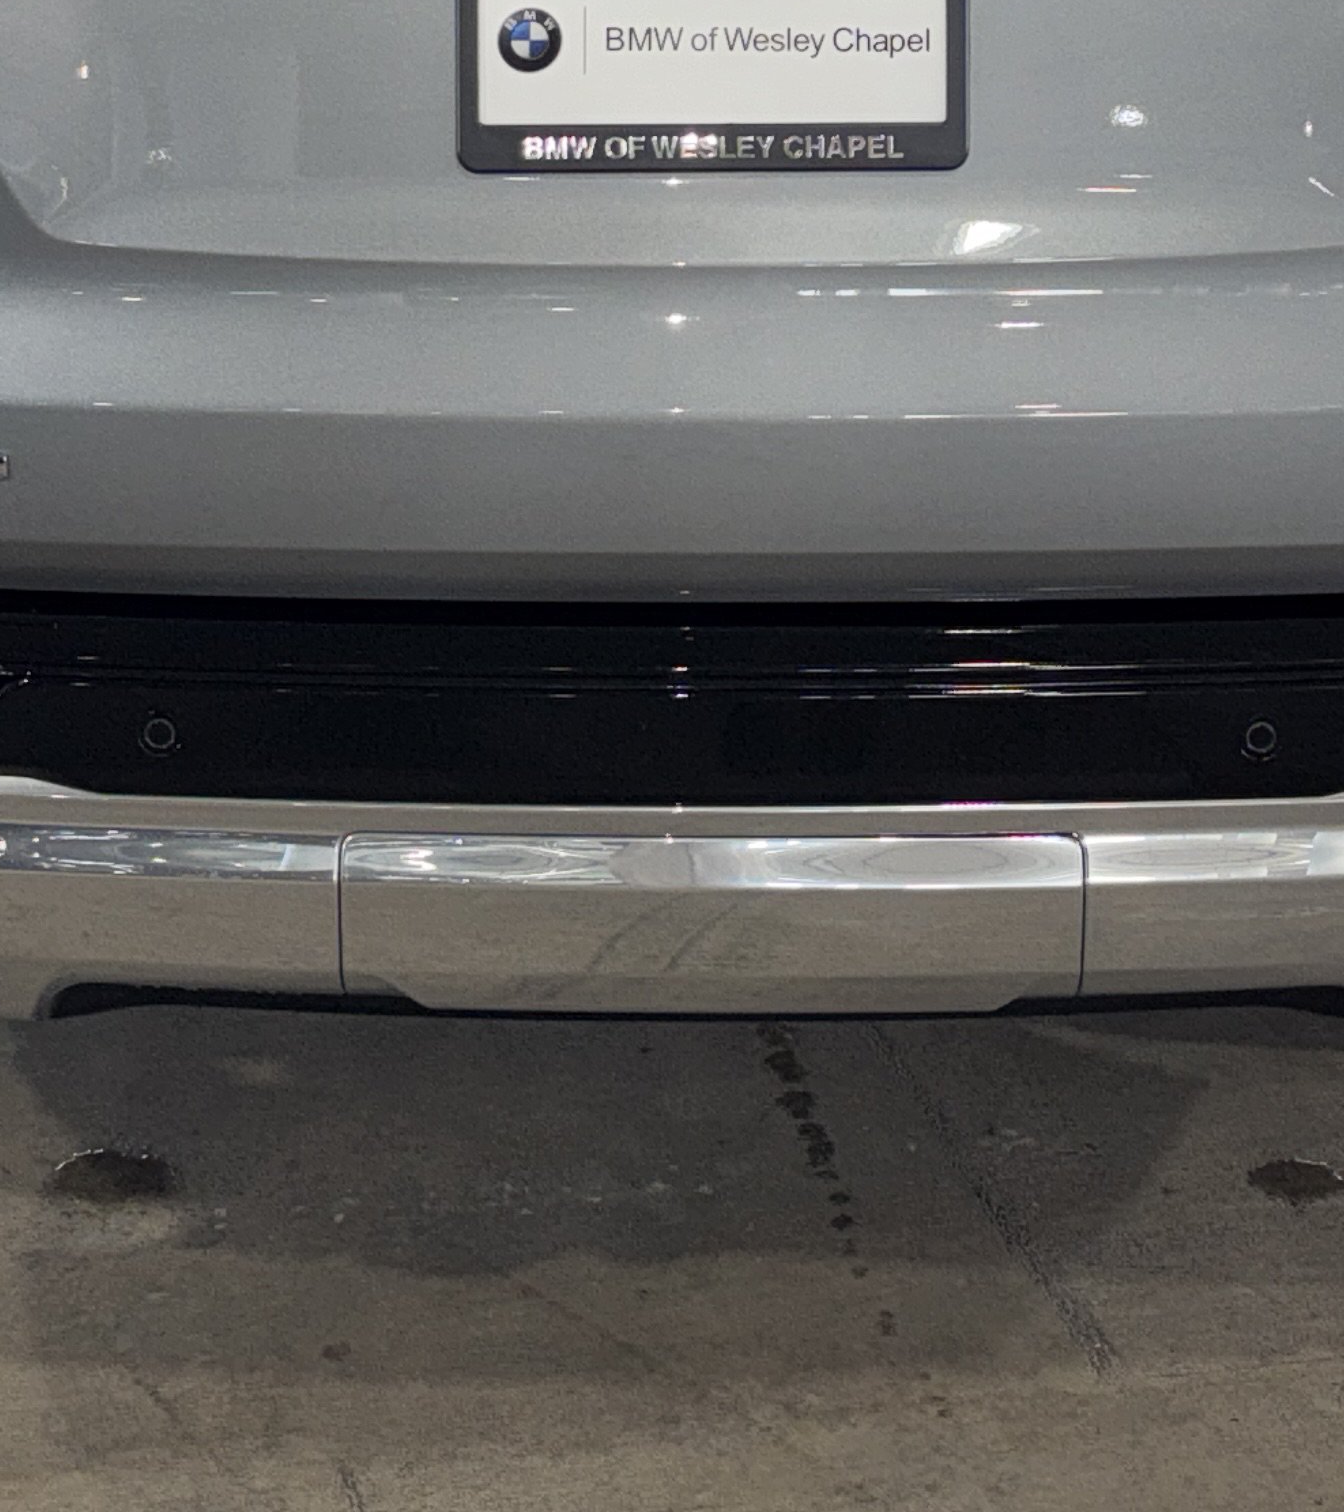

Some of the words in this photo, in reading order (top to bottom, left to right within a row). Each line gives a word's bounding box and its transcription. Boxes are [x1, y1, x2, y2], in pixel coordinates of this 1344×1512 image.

[606, 26, 684, 51] BMW
[691, 26, 719, 52] of
[724, 26, 826, 59] Wesley
[832, 27, 931, 59] Chapel
[522, 136, 596, 161] BMW
[604, 136, 646, 160] OF
[652, 133, 774, 160] WESLEY
[782, 134, 905, 160] CHAPEL
